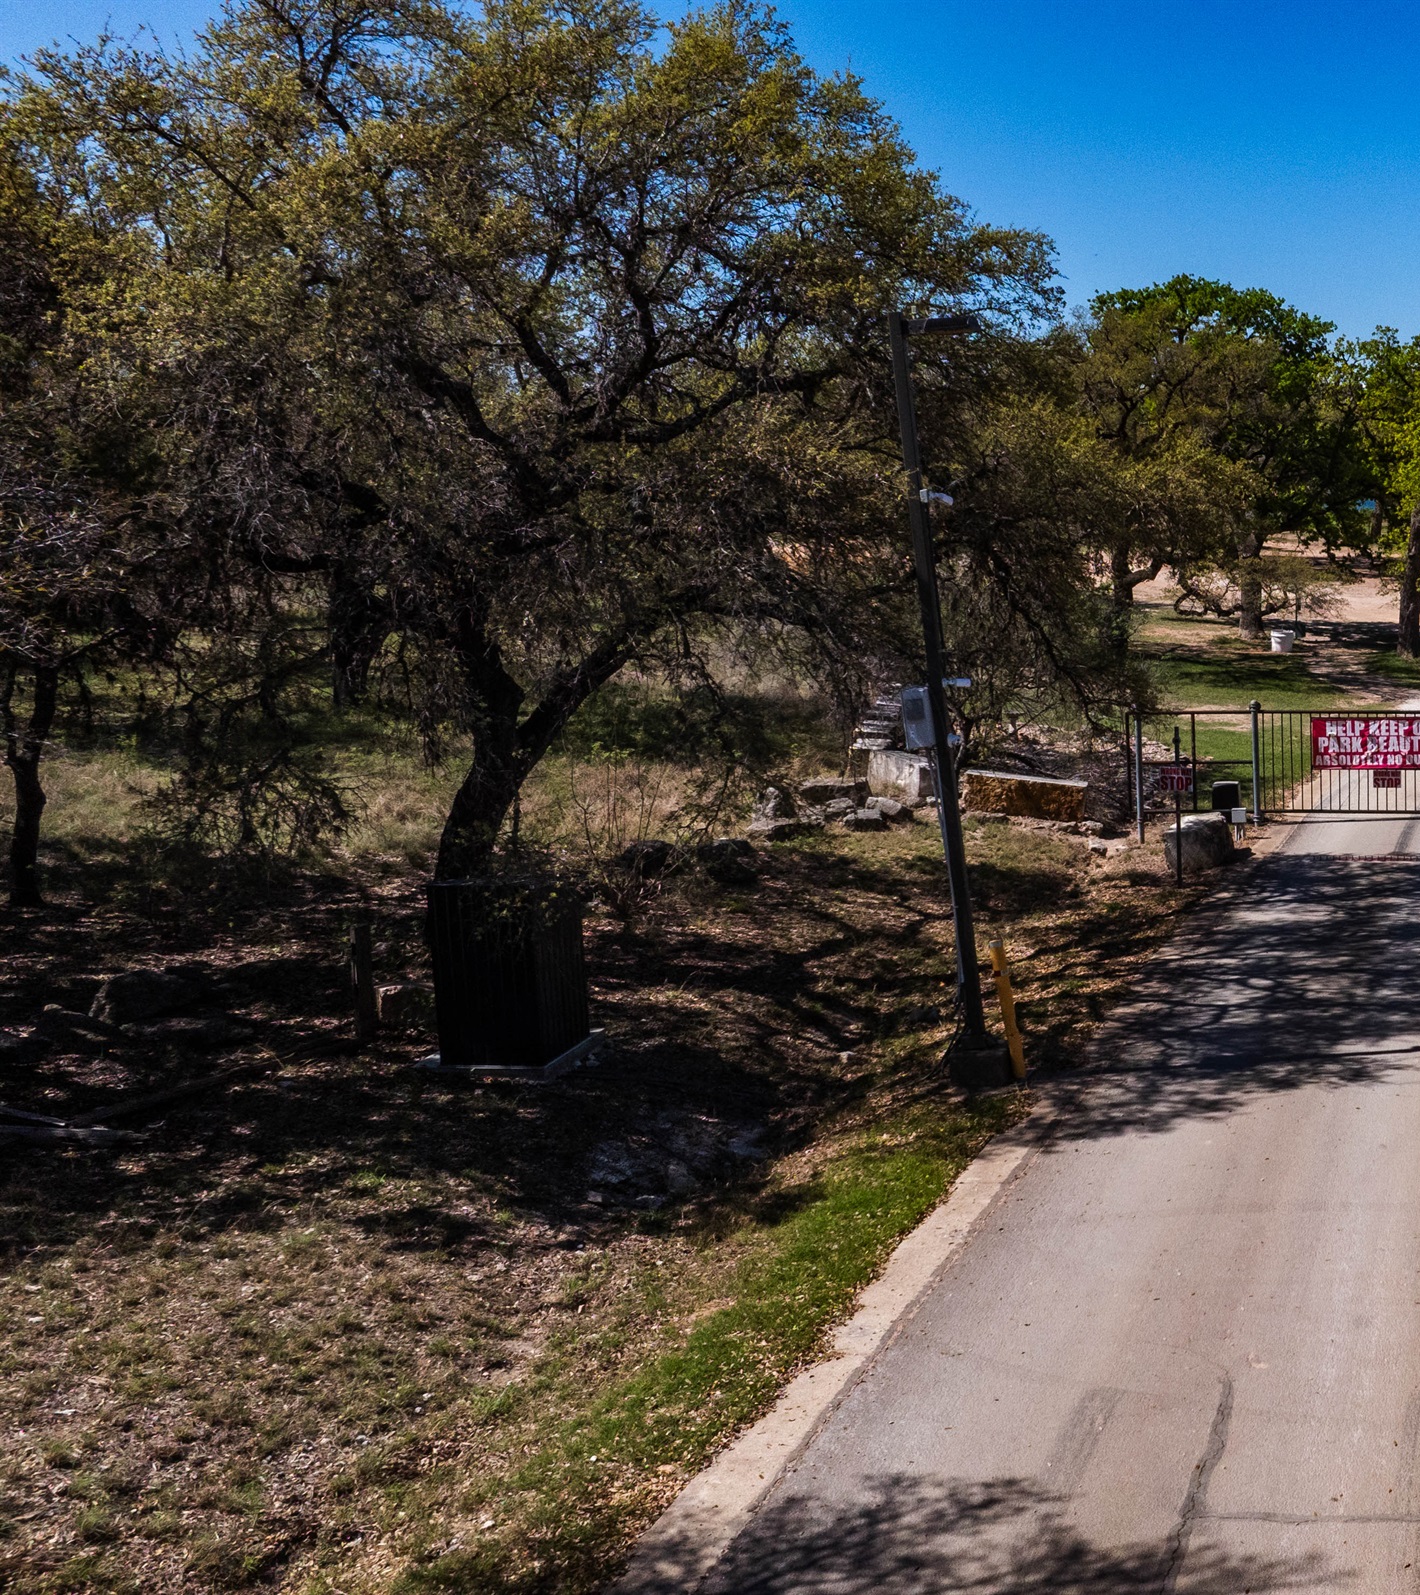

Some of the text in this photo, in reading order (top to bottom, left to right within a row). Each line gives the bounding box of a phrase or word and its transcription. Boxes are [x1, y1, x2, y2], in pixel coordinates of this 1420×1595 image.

[1325, 721, 1365, 736] HELP
[1369, 720, 1408, 736] KEEP
[1318, 737, 1362, 753] PARK
[1316, 754, 1383, 766] ABSOLUTELY
[1387, 754, 1403, 765] NO
[1160, 776, 1192, 791] STOP
[1374, 778, 1400, 787] STOP
